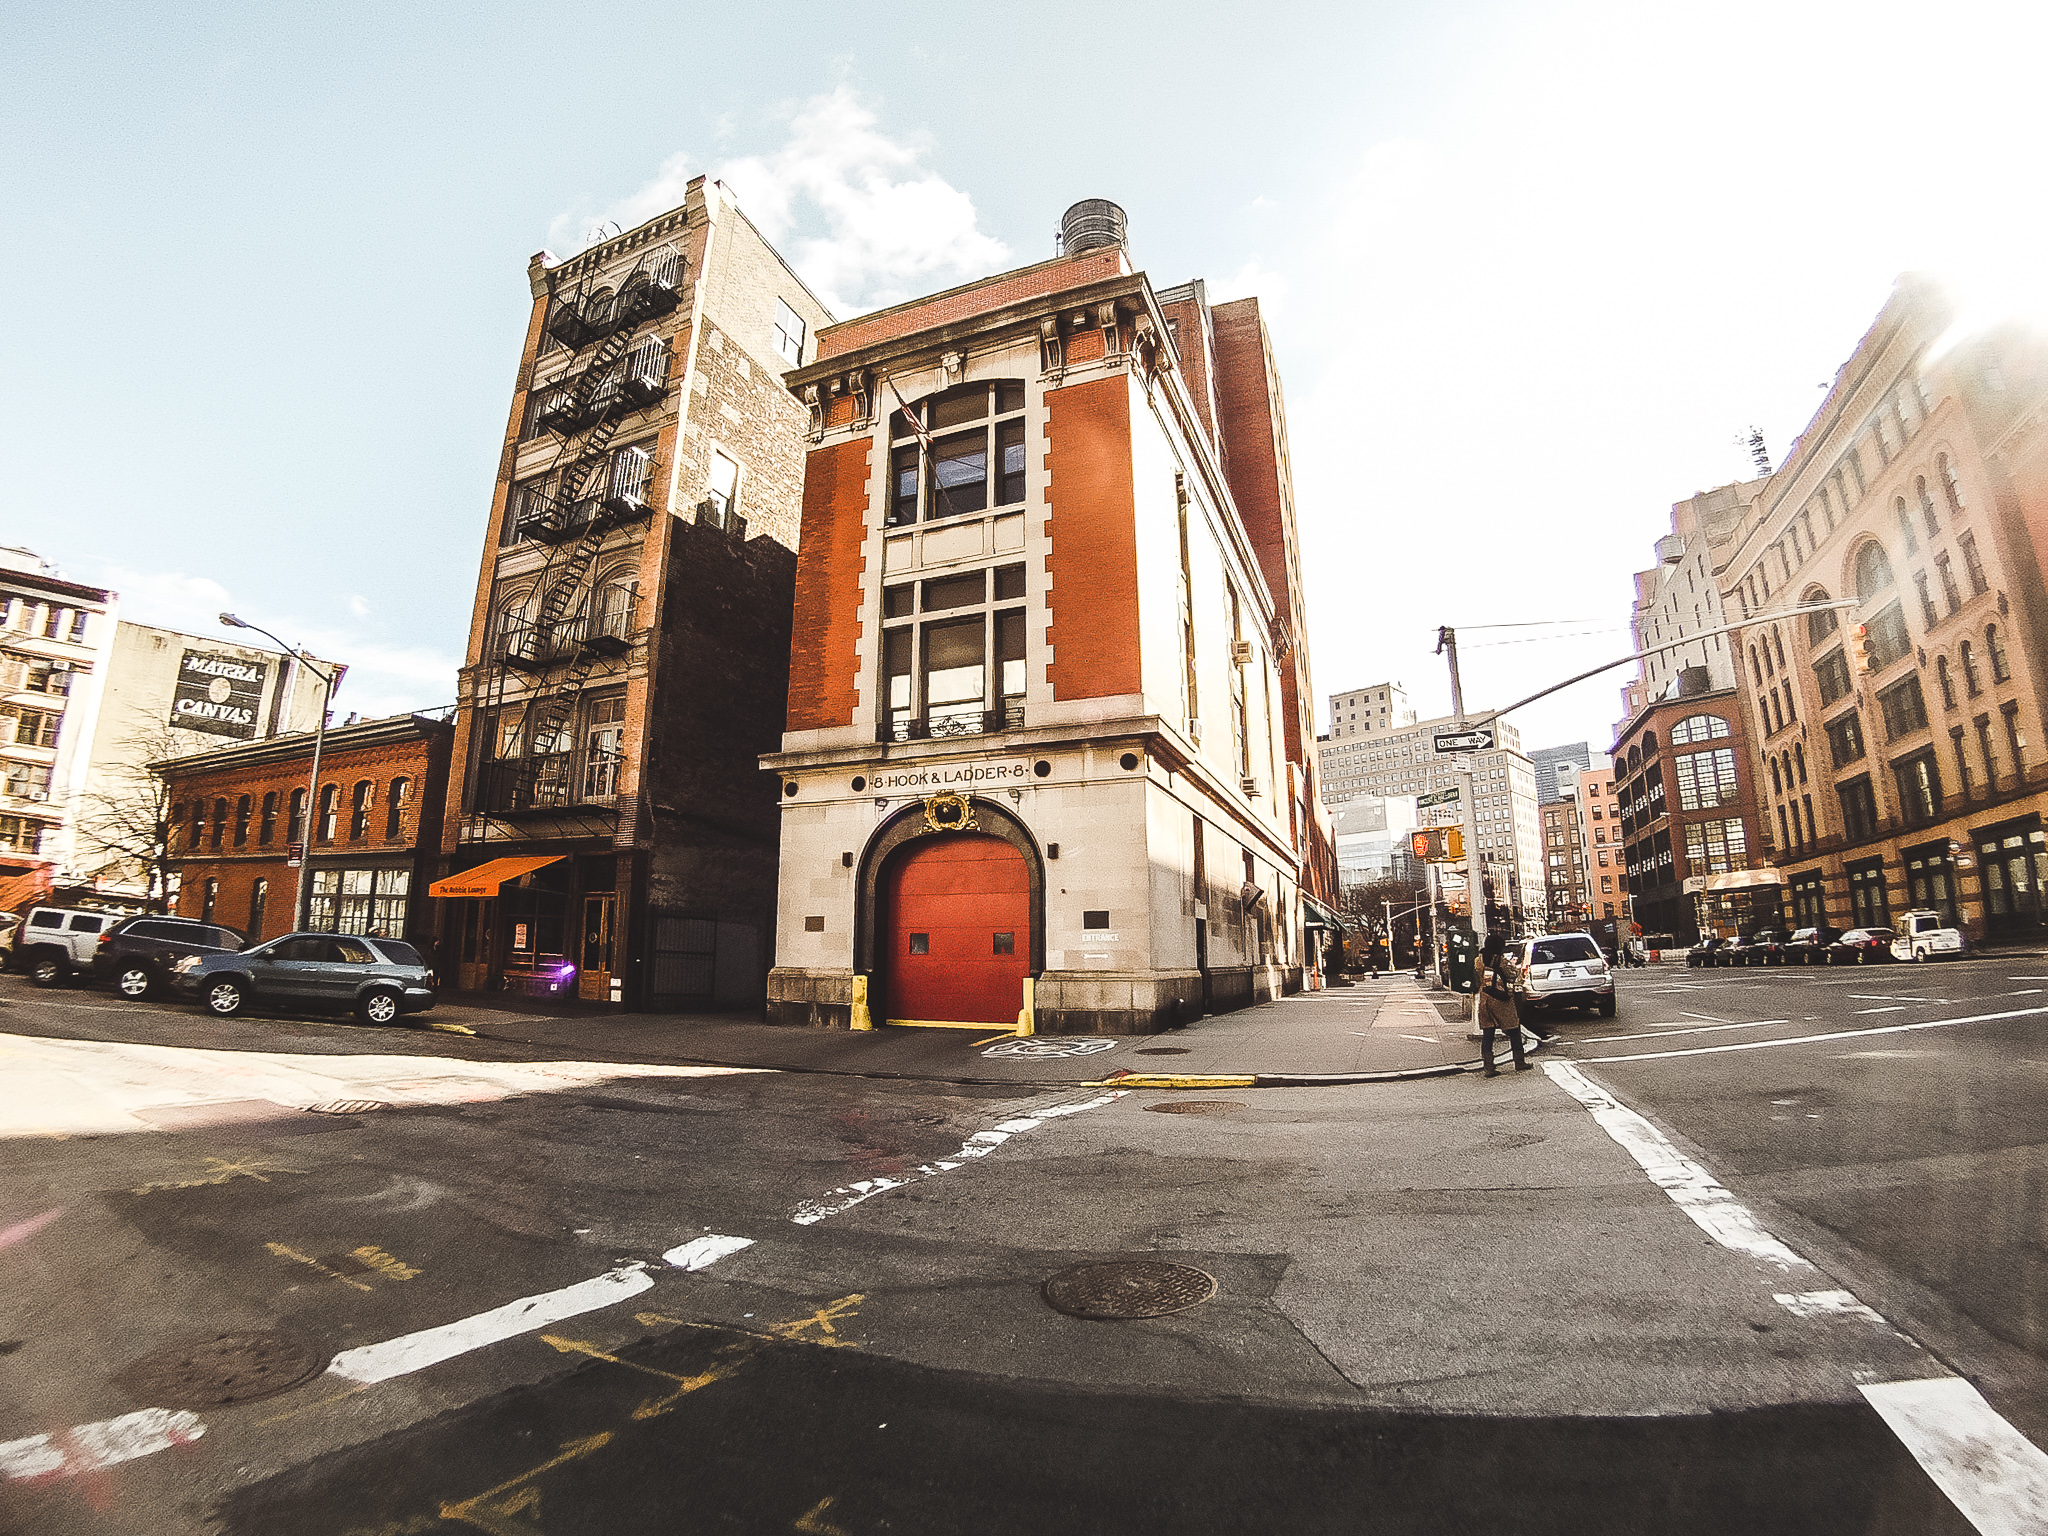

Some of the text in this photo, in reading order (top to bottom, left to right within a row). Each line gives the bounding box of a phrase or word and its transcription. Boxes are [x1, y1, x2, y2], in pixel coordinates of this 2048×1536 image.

[177, 698, 253, 724] CANVAS
[1439, 735, 1486, 748] ONE WAY
[931, 772, 942, 784] &
[1081, 933, 1120, 942] ENTRANCE
